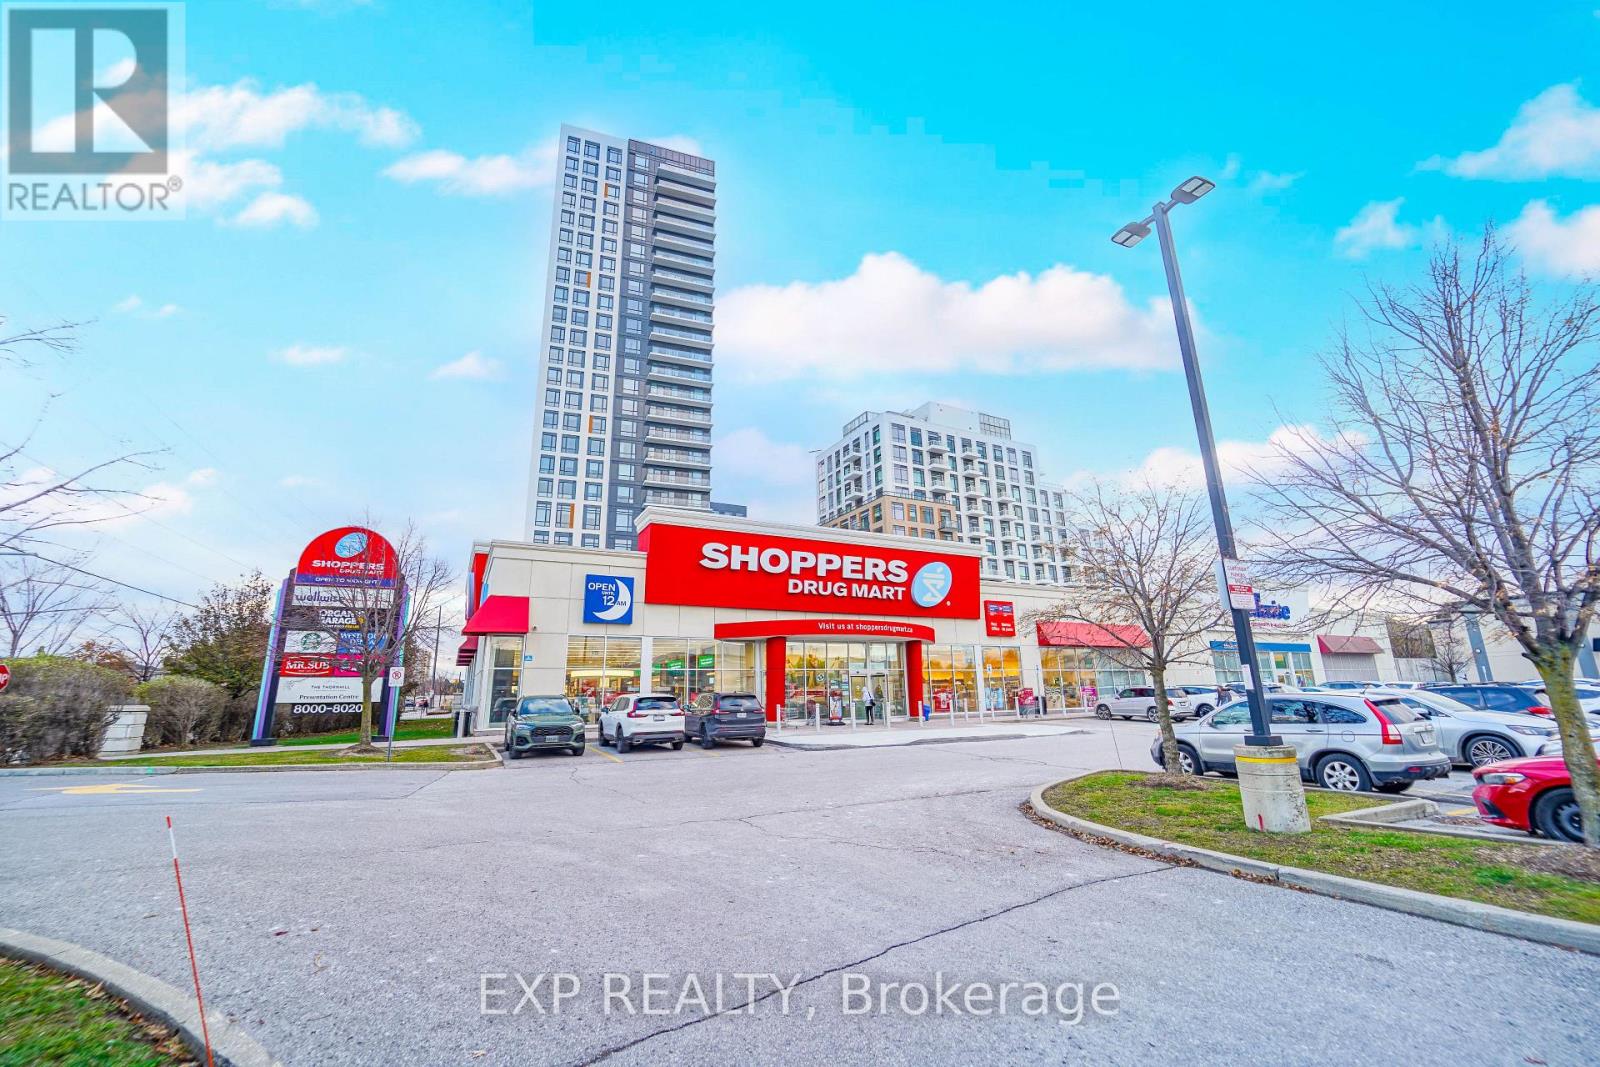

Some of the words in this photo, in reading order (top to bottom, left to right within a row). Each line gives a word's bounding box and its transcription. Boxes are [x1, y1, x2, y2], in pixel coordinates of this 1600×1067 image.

[311, 560, 385, 570] SHOPPERS
[699, 542, 909, 583] SHOPPERS
[588, 583, 615, 591] OPEN
[788, 578, 848, 598] DRUG
[851, 583, 906, 601] MART
[603, 596, 615, 605] 12
[818, 622, 835, 631] Visit
[846, 623, 854, 631] at
[299, 693, 339, 701] Presentation
[293, 703, 364, 714] 8000-8020
